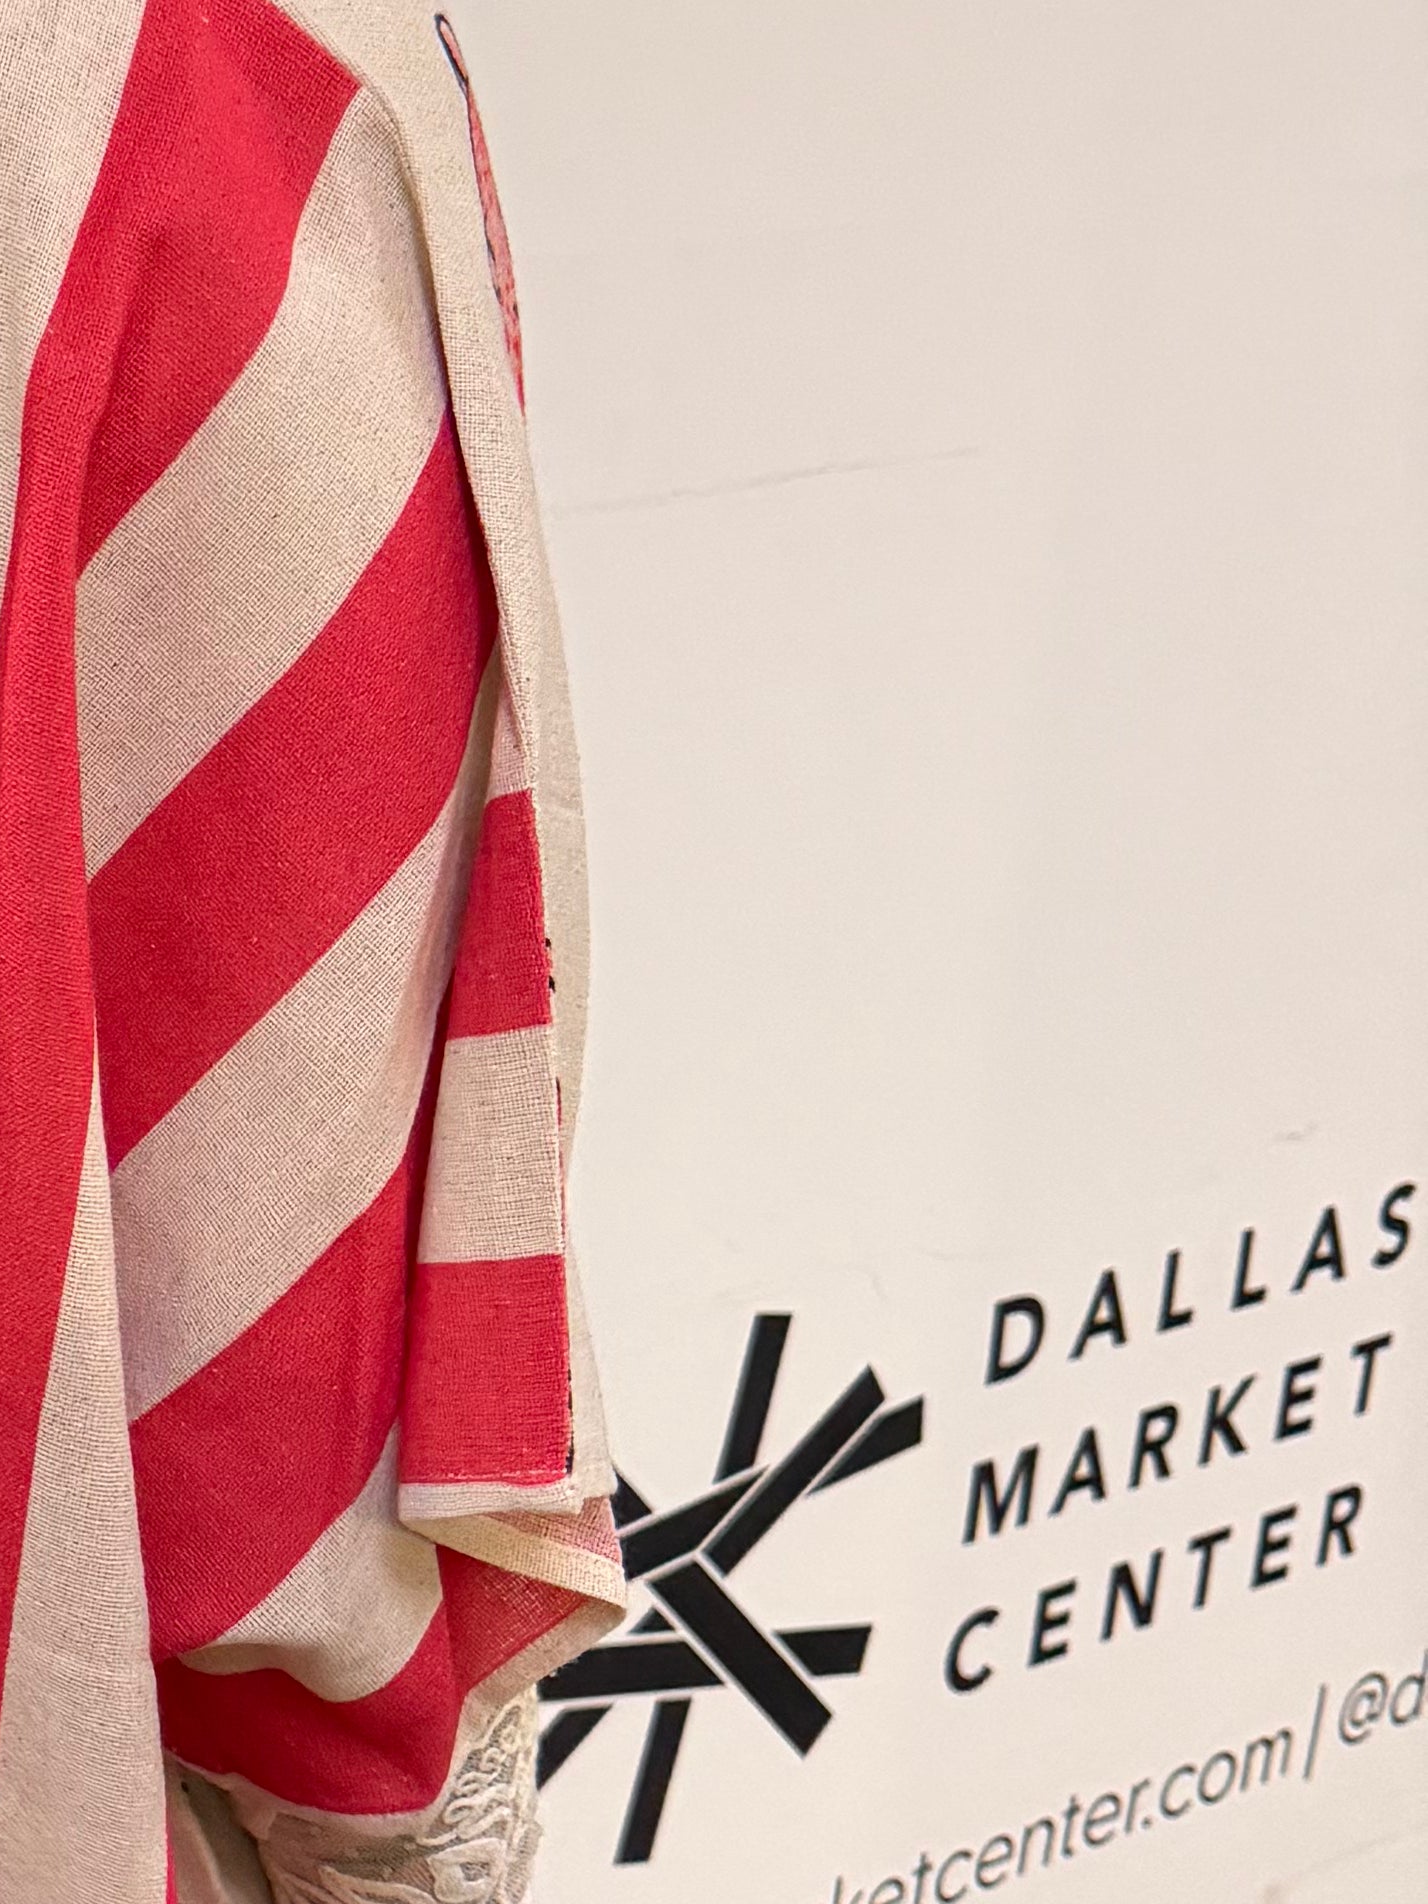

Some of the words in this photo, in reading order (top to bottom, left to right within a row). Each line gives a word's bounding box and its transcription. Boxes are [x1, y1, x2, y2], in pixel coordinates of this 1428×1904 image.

[984, 1183, 1418, 1386] DALLAS
[960, 1334, 1395, 1546] MARKET
[943, 1484, 1365, 1695] CENTER
